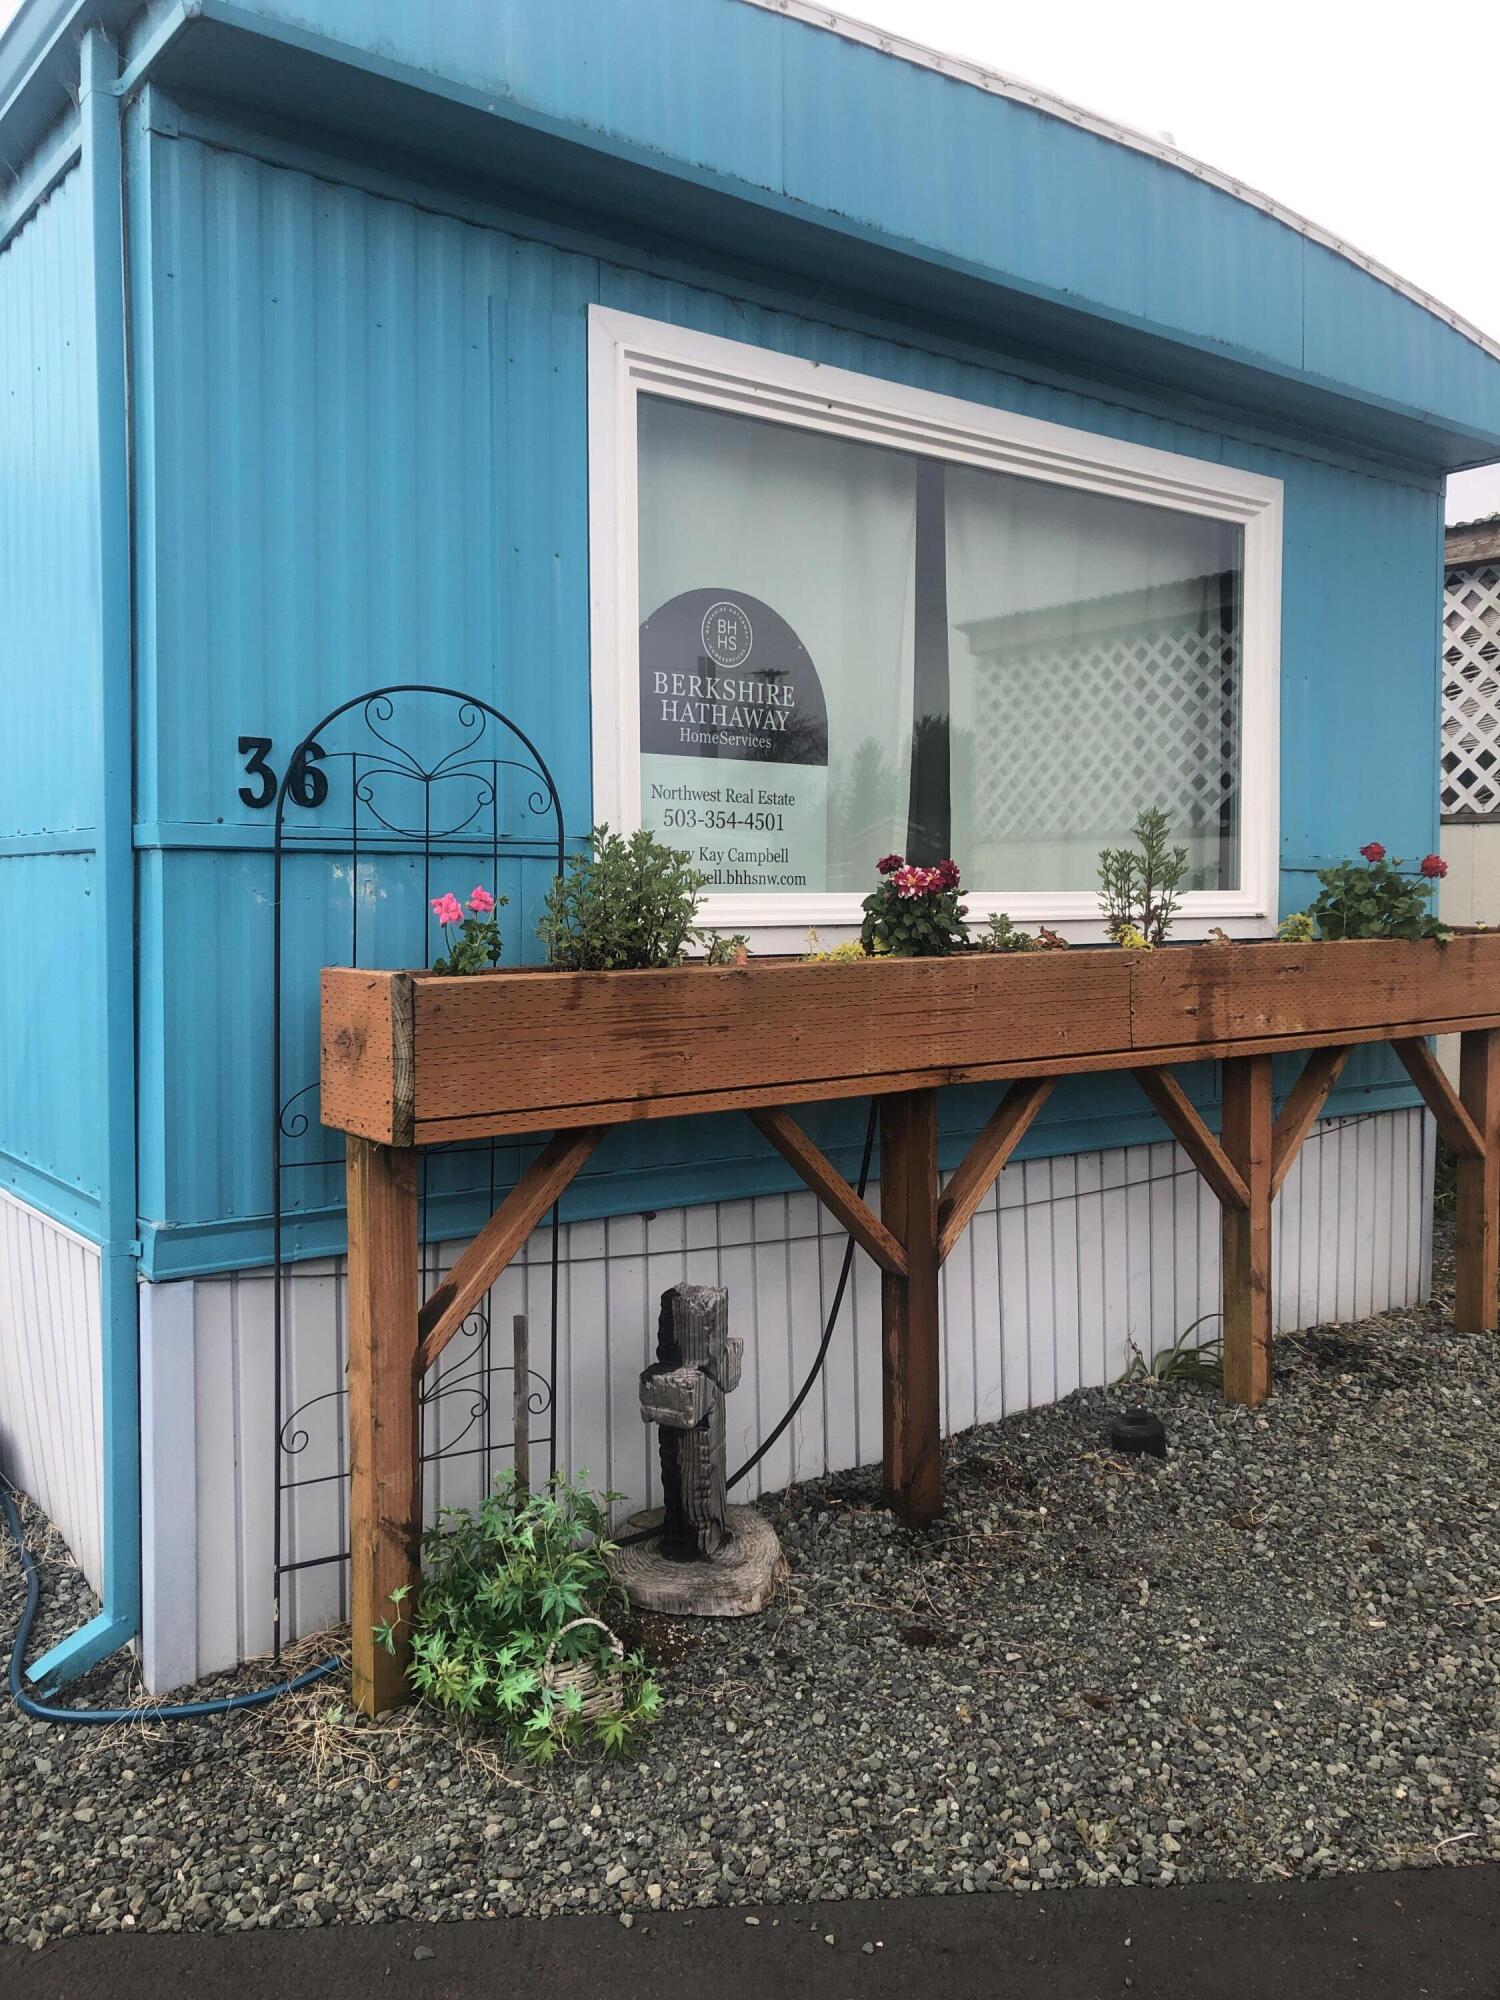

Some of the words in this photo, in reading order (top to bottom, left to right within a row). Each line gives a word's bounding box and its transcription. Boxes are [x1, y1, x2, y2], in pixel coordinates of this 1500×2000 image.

[717, 618, 737, 635] BH
[717, 634, 737, 651] HS
[653, 671, 795, 707] BERKSHIRE
[660, 699, 790, 731] HATHAWAY
[680, 727, 772, 748] HomeServices
[238, 736, 328, 808] 36
[651, 784, 721, 803] Northwest
[726, 788, 753, 804] Real
[758, 790, 795, 806] Estate
[663, 808, 784, 831] 503-354-4501
[698, 846, 724, 865] Kay
[728, 848, 789, 866] Campbell
